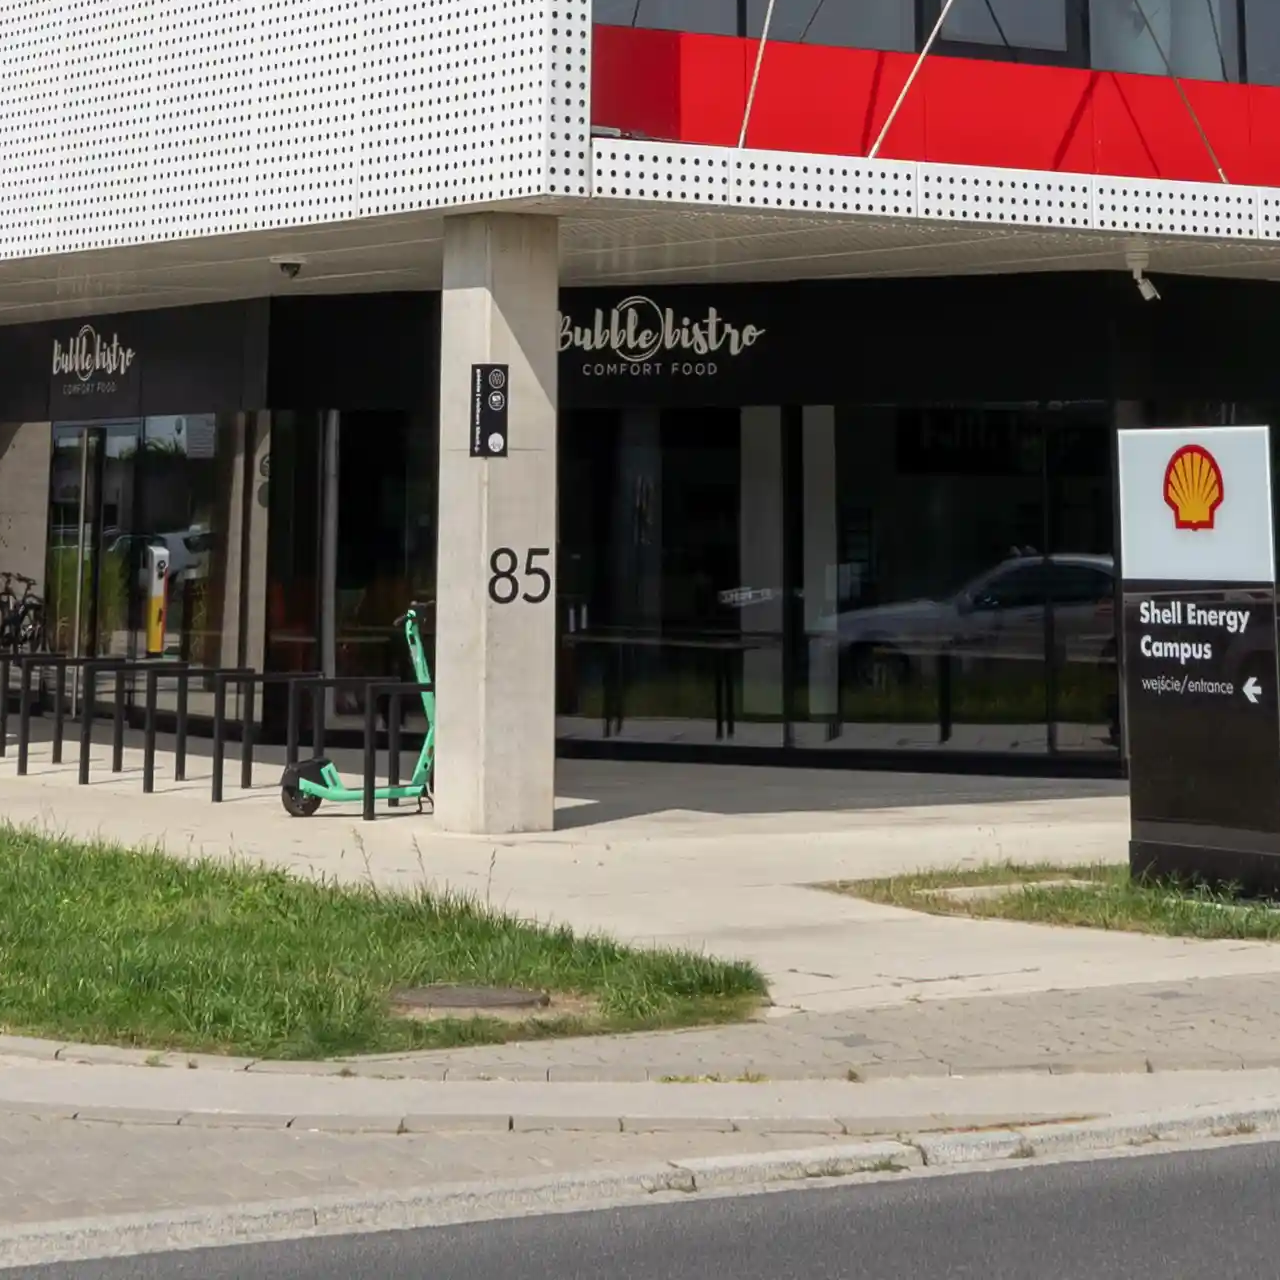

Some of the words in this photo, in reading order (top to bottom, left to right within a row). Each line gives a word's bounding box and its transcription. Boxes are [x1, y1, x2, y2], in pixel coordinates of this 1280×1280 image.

[664, 306, 766, 356] bistro
[52, 336, 93, 375] Bubble
[95, 333, 136, 375] bistro
[582, 363, 662, 376] COMFORT
[671, 362, 718, 375] FOOD
[488, 547, 551, 604] 85
[1140, 600, 1181, 624] Shell
[1187, 603, 1250, 633] Energy
[1140, 634, 1212, 665] Campus
